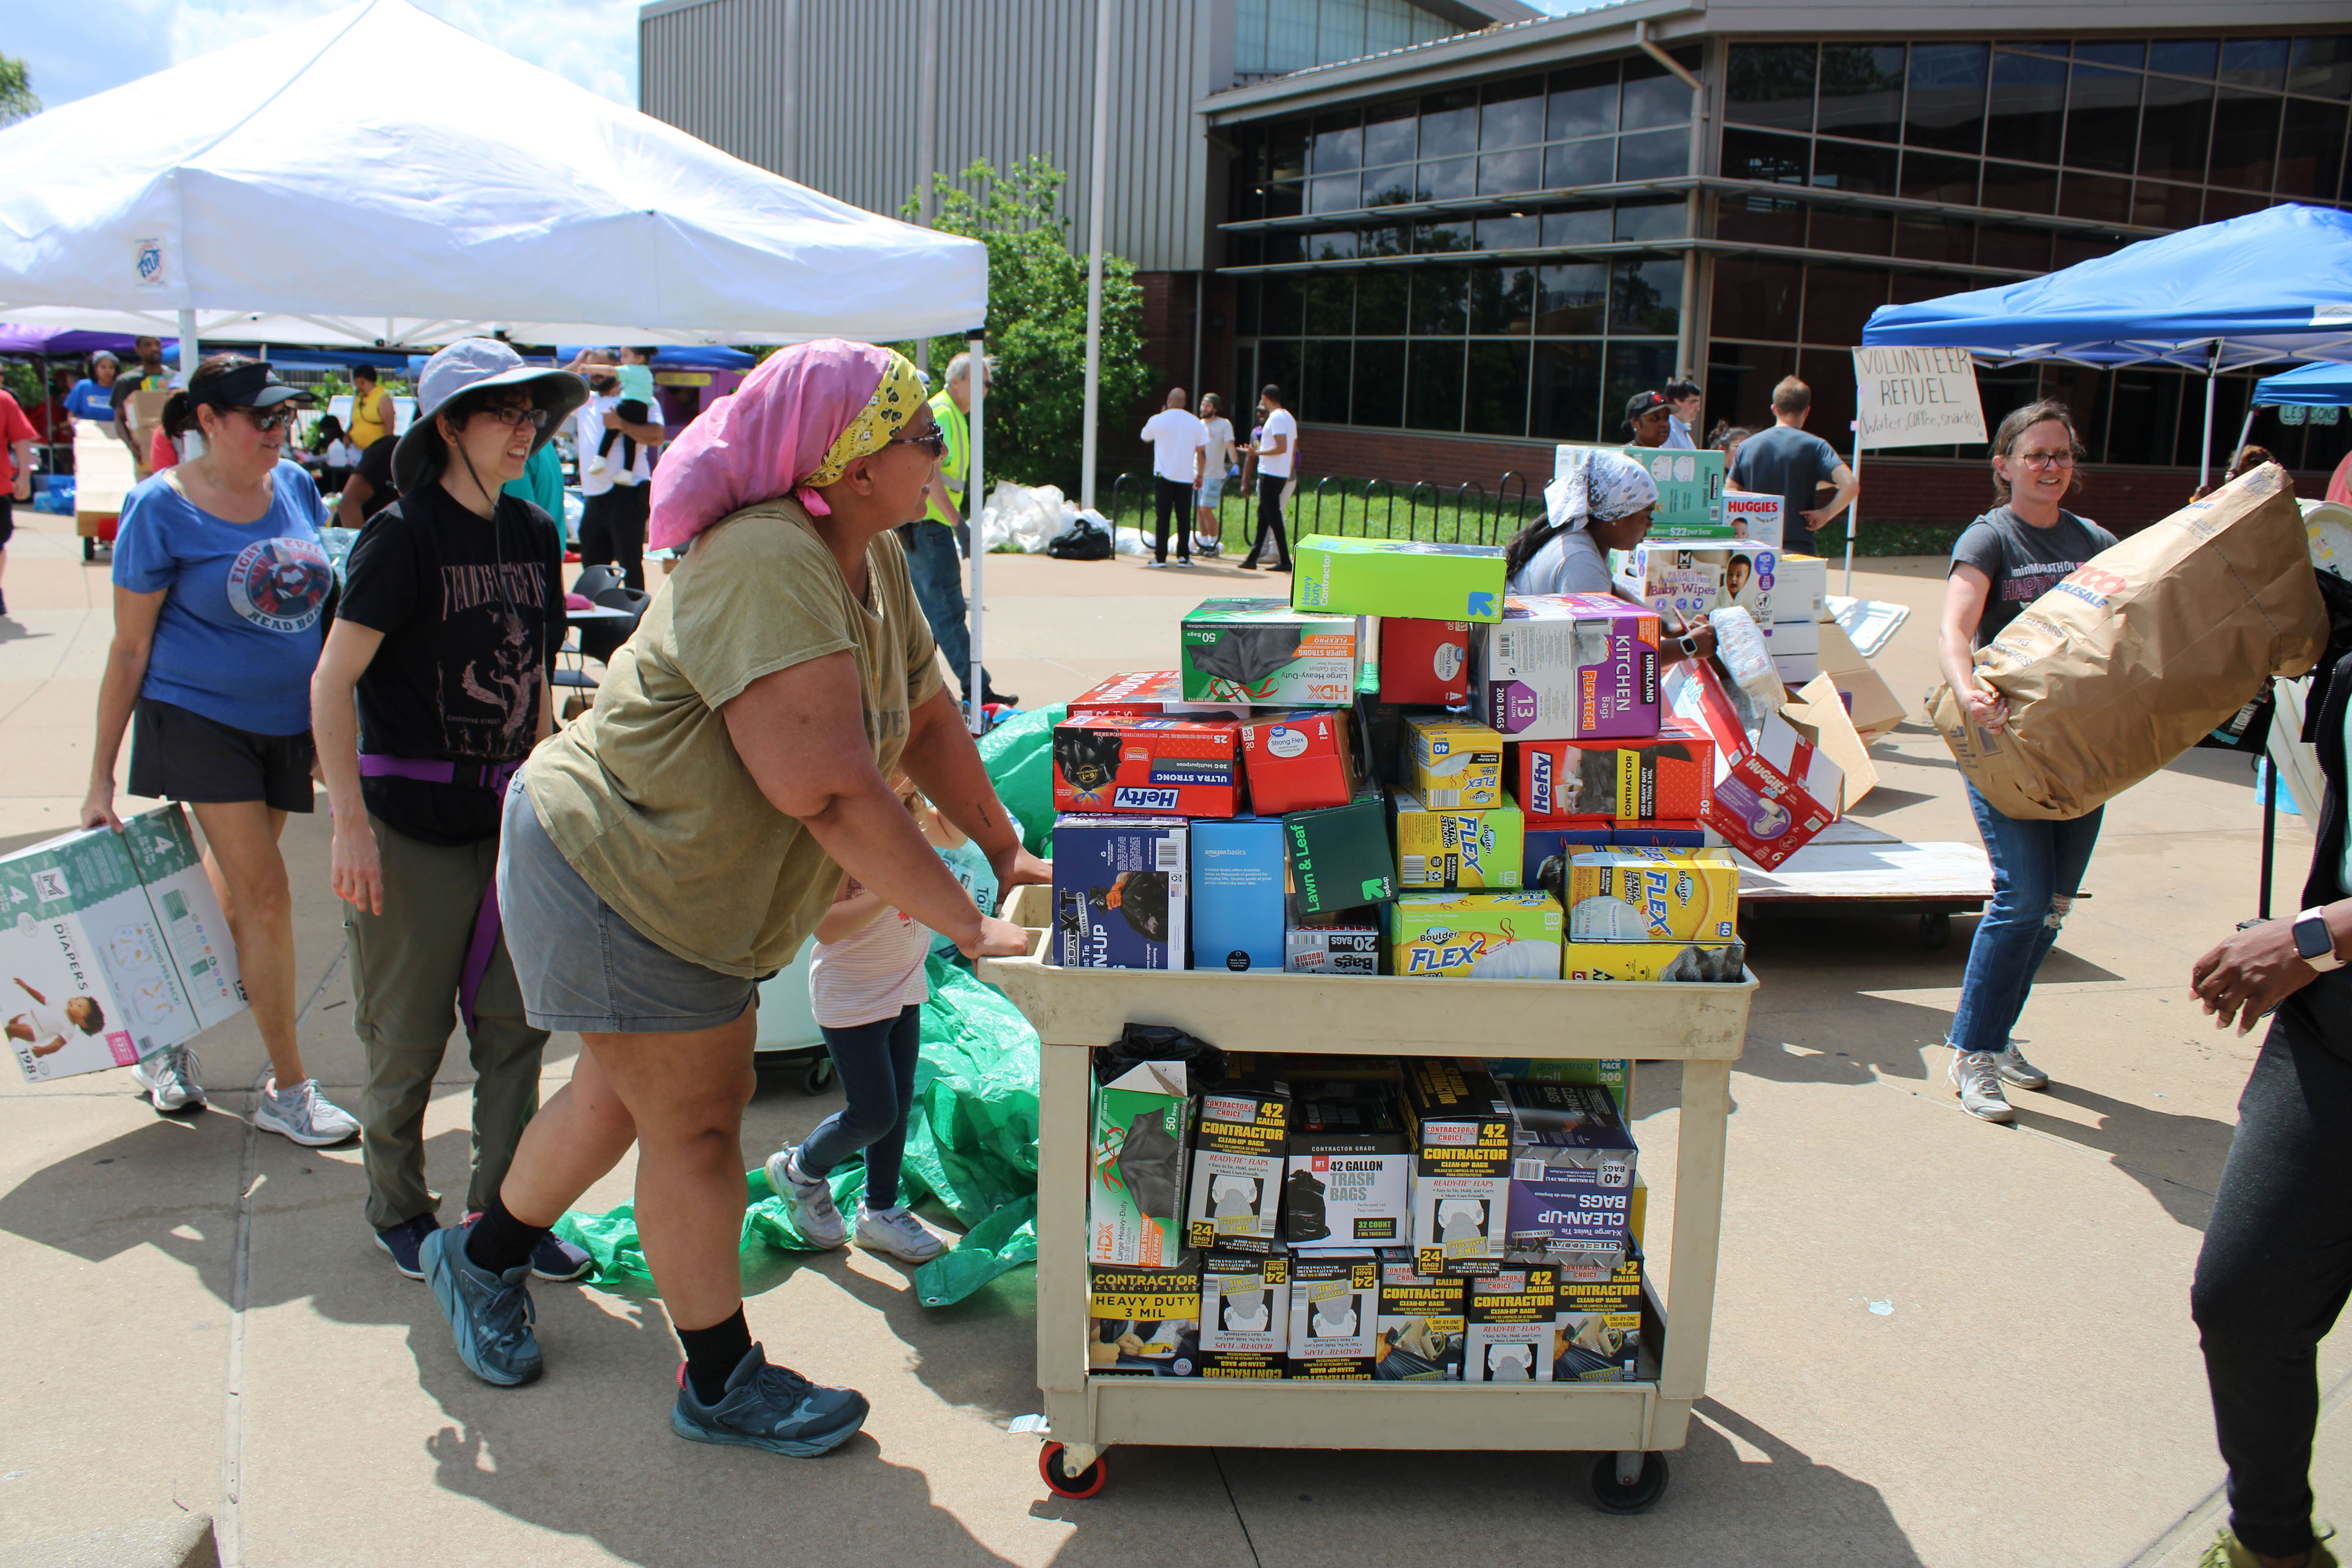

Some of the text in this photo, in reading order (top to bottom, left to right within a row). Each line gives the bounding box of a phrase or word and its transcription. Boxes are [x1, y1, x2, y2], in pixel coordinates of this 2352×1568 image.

[1858, 347, 1972, 375] VOLUNTEER
[1881, 378, 1961, 405] REFUEL
[1728, 500, 1778, 513] HUGGIES
[1670, 527, 1687, 537] $22
[284, 540, 322, 555] EVIL
[232, 545, 262, 584] FIGHT
[1320, 553, 1331, 606] Contractor
[1302, 576, 1313, 605] Heavy
[1311, 582, 1322, 606] Duty
[1651, 583, 1716, 596] Baby Wipes
[1492, 593, 1501, 619] up&up
[248, 604, 322, 631] READ BOO
[1202, 632, 1216, 643] 50
[2040, 623, 2064, 638] BAGS
[1615, 635, 1630, 711] KITCHEN
[1096, 672, 1158, 701] OUTDOOR
[1307, 684, 1348, 700] HDX
[1683, 674, 1705, 704] plus
[1517, 696, 1534, 718] 13
[1600, 696, 1610, 719] Bags
[480, 715, 500, 725] STREET
[1214, 734, 1227, 744] 25
[1435, 744, 1448, 753] 40
[1199, 774, 1227, 783] ULTRA
[1463, 776, 1496, 791] FLEX
[1533, 755, 1551, 812] Hefty
[1745, 757, 1789, 795] HUGGIES
[1117, 789, 1174, 806] Hefty
[1760, 785, 1779, 799] plus
[1700, 799, 1710, 815] 20
[1448, 818, 1458, 845] EXTRA
[154, 835, 175, 854] 4
[1457, 816, 1485, 875] FLEX
[1771, 851, 1785, 862] 6
[1290, 824, 1320, 912] Lawn & Leaf
[1506, 872, 1515, 884] 80
[10, 884, 29, 905] 4
[1383, 876, 1392, 897] up&up
[1678, 870, 1687, 907] Boulder
[1644, 870, 1673, 937] FLEX
[1545, 914, 1559, 923] 80
[1721, 923, 1730, 935] 40
[54, 924, 89, 991] DIAPERS
[1334, 955, 1373, 970] Bags
[145, 927, 164, 964] DESIGNS
[161, 964, 171, 981] PER
[167, 981, 181, 1005] PACK!
[20, 1049, 37, 1074] 198
[1537, 1061, 1593, 1071] drawstring
[1599, 1072, 1622, 1082] 200
[1205, 1100, 1254, 1111] CONTRACTOR'S
[1261, 1102, 1283, 1118] 42
[1166, 1117, 1176, 1131] 50
[1256, 1117, 1285, 1126] GALLON
[1201, 1122, 1284, 1140] CONTRACTOR
[1330, 1161, 1343, 1171] 42
[1330, 1172, 1375, 1186] TRASH
[1604, 1174, 1621, 1183] 40
[1118, 1200, 1128, 1243] Heavy-Duty
[1538, 1210, 1625, 1226] CLEAN-UP
[1193, 1224, 1212, 1236] 24
[1097, 1223, 1114, 1260] HDX
[1550, 1240, 1618, 1251] STEELCOAT
[1265, 1272, 1284, 1283] 24
[1530, 1271, 1552, 1285] 42
[1560, 1285, 1640, 1296] CONTRACTOR
[1096, 1297, 1196, 1306] HEAVY DUTY
[1474, 1295, 1554, 1307] CONTRACTOR
[1125, 1308, 1166, 1317] 3 MIL
